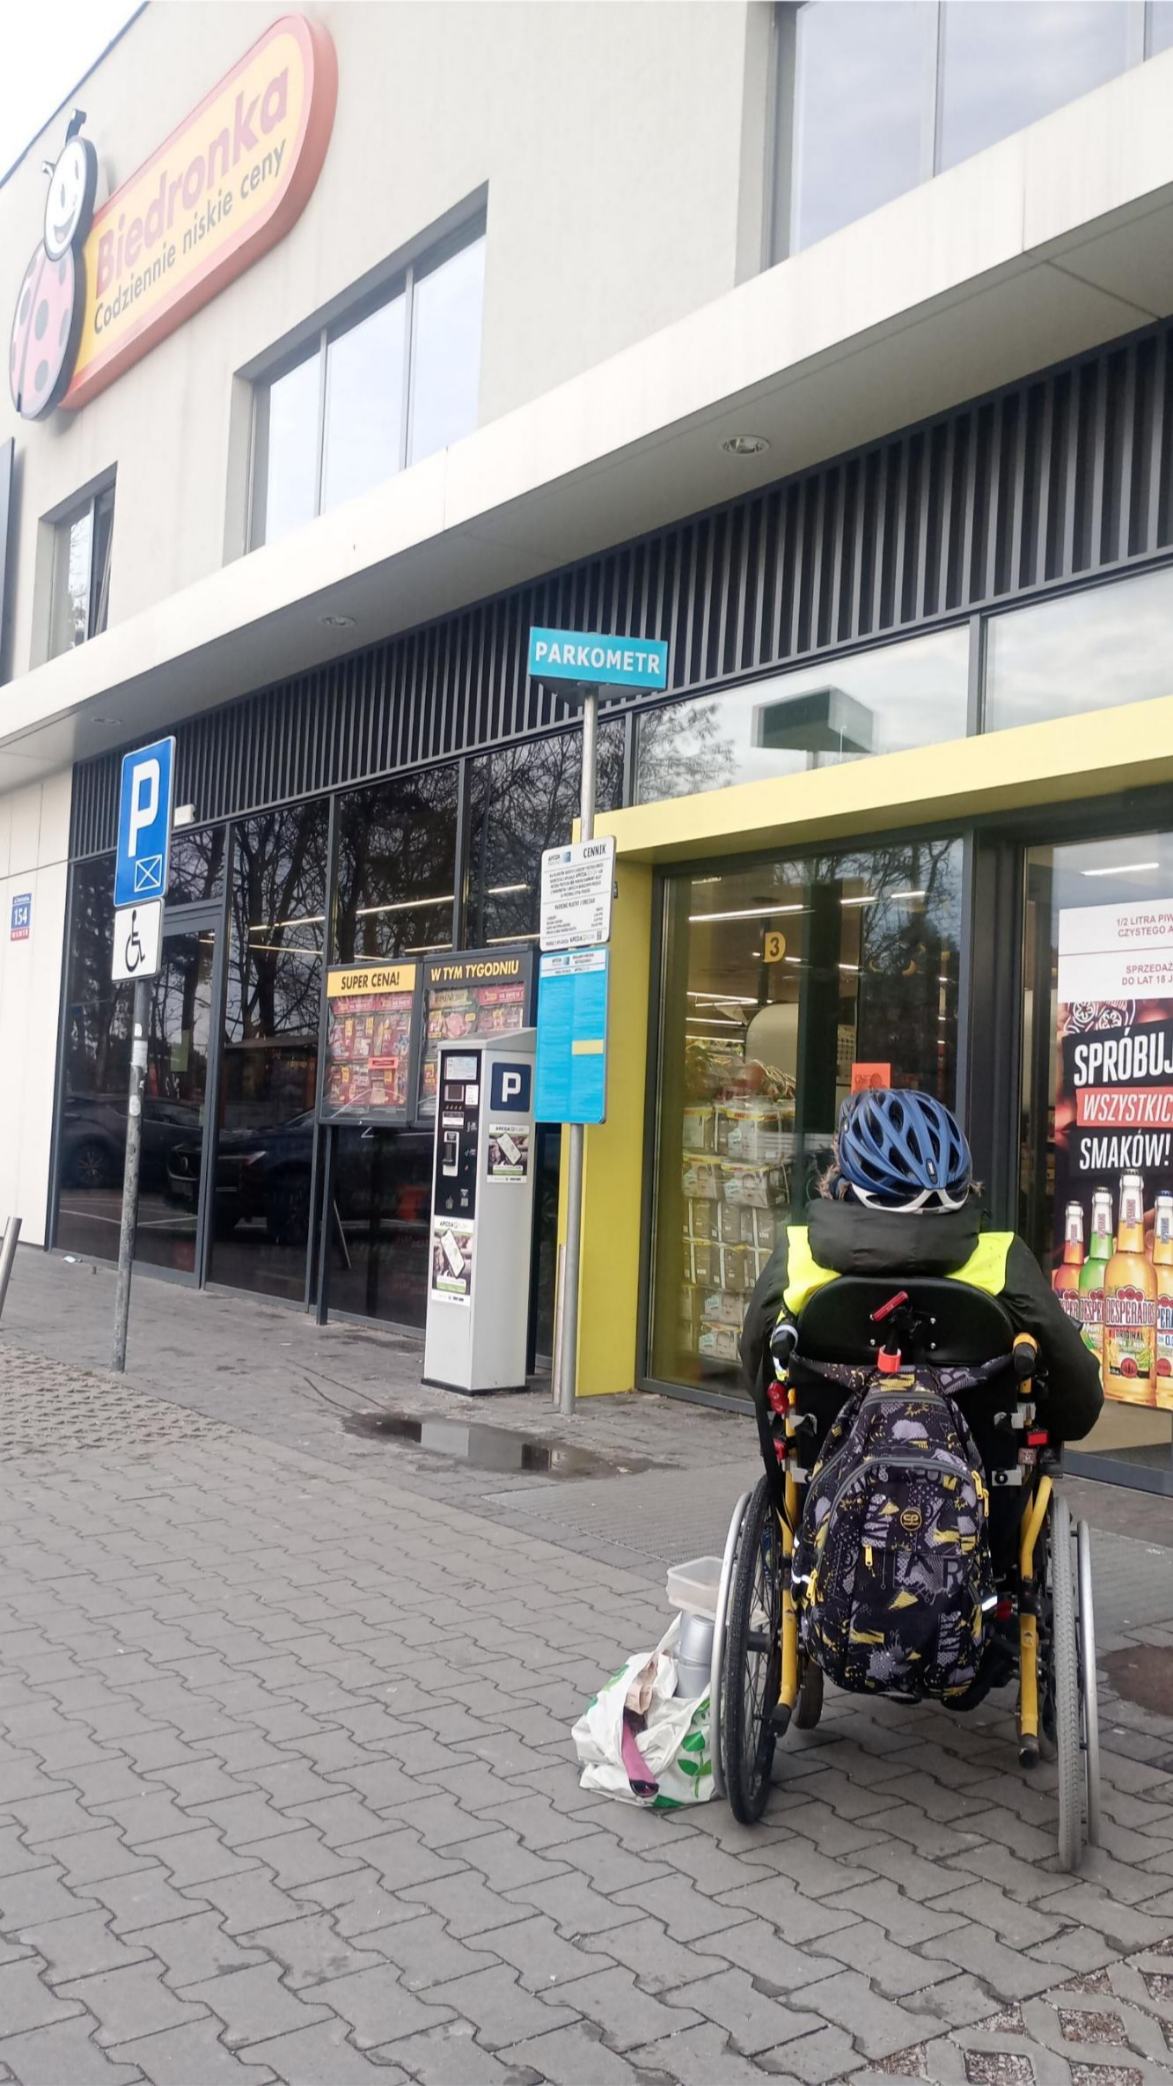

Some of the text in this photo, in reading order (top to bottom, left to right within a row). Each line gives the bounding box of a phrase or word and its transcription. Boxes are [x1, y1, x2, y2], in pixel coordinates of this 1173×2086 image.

[96, 67, 290, 299] Biedronka
[94, 139, 288, 335] Codziennie niskie ceny
[535, 640, 661, 675] PARKOMETR
[128, 757, 161, 858] P
[583, 843, 607, 859] CENNIK
[14, 906, 28, 926] 154
[1130, 915, 1157, 925] LITRA
[1118, 925, 1166, 937] CZYSTEGO
[769, 936, 780, 957] 3
[341, 971, 400, 991] SUPER CENA!
[431, 959, 520, 982] W TYM TYGODNIU
[1122, 976, 1135, 986] DO
[1137, 975, 1153, 985] LAT
[1156, 974, 1166, 984] 18
[501, 1071, 522, 1103] P
[1079, 1128, 1170, 1170] SMAKÓW!
[1106, 1297, 1156, 1324] DESPERADOS
